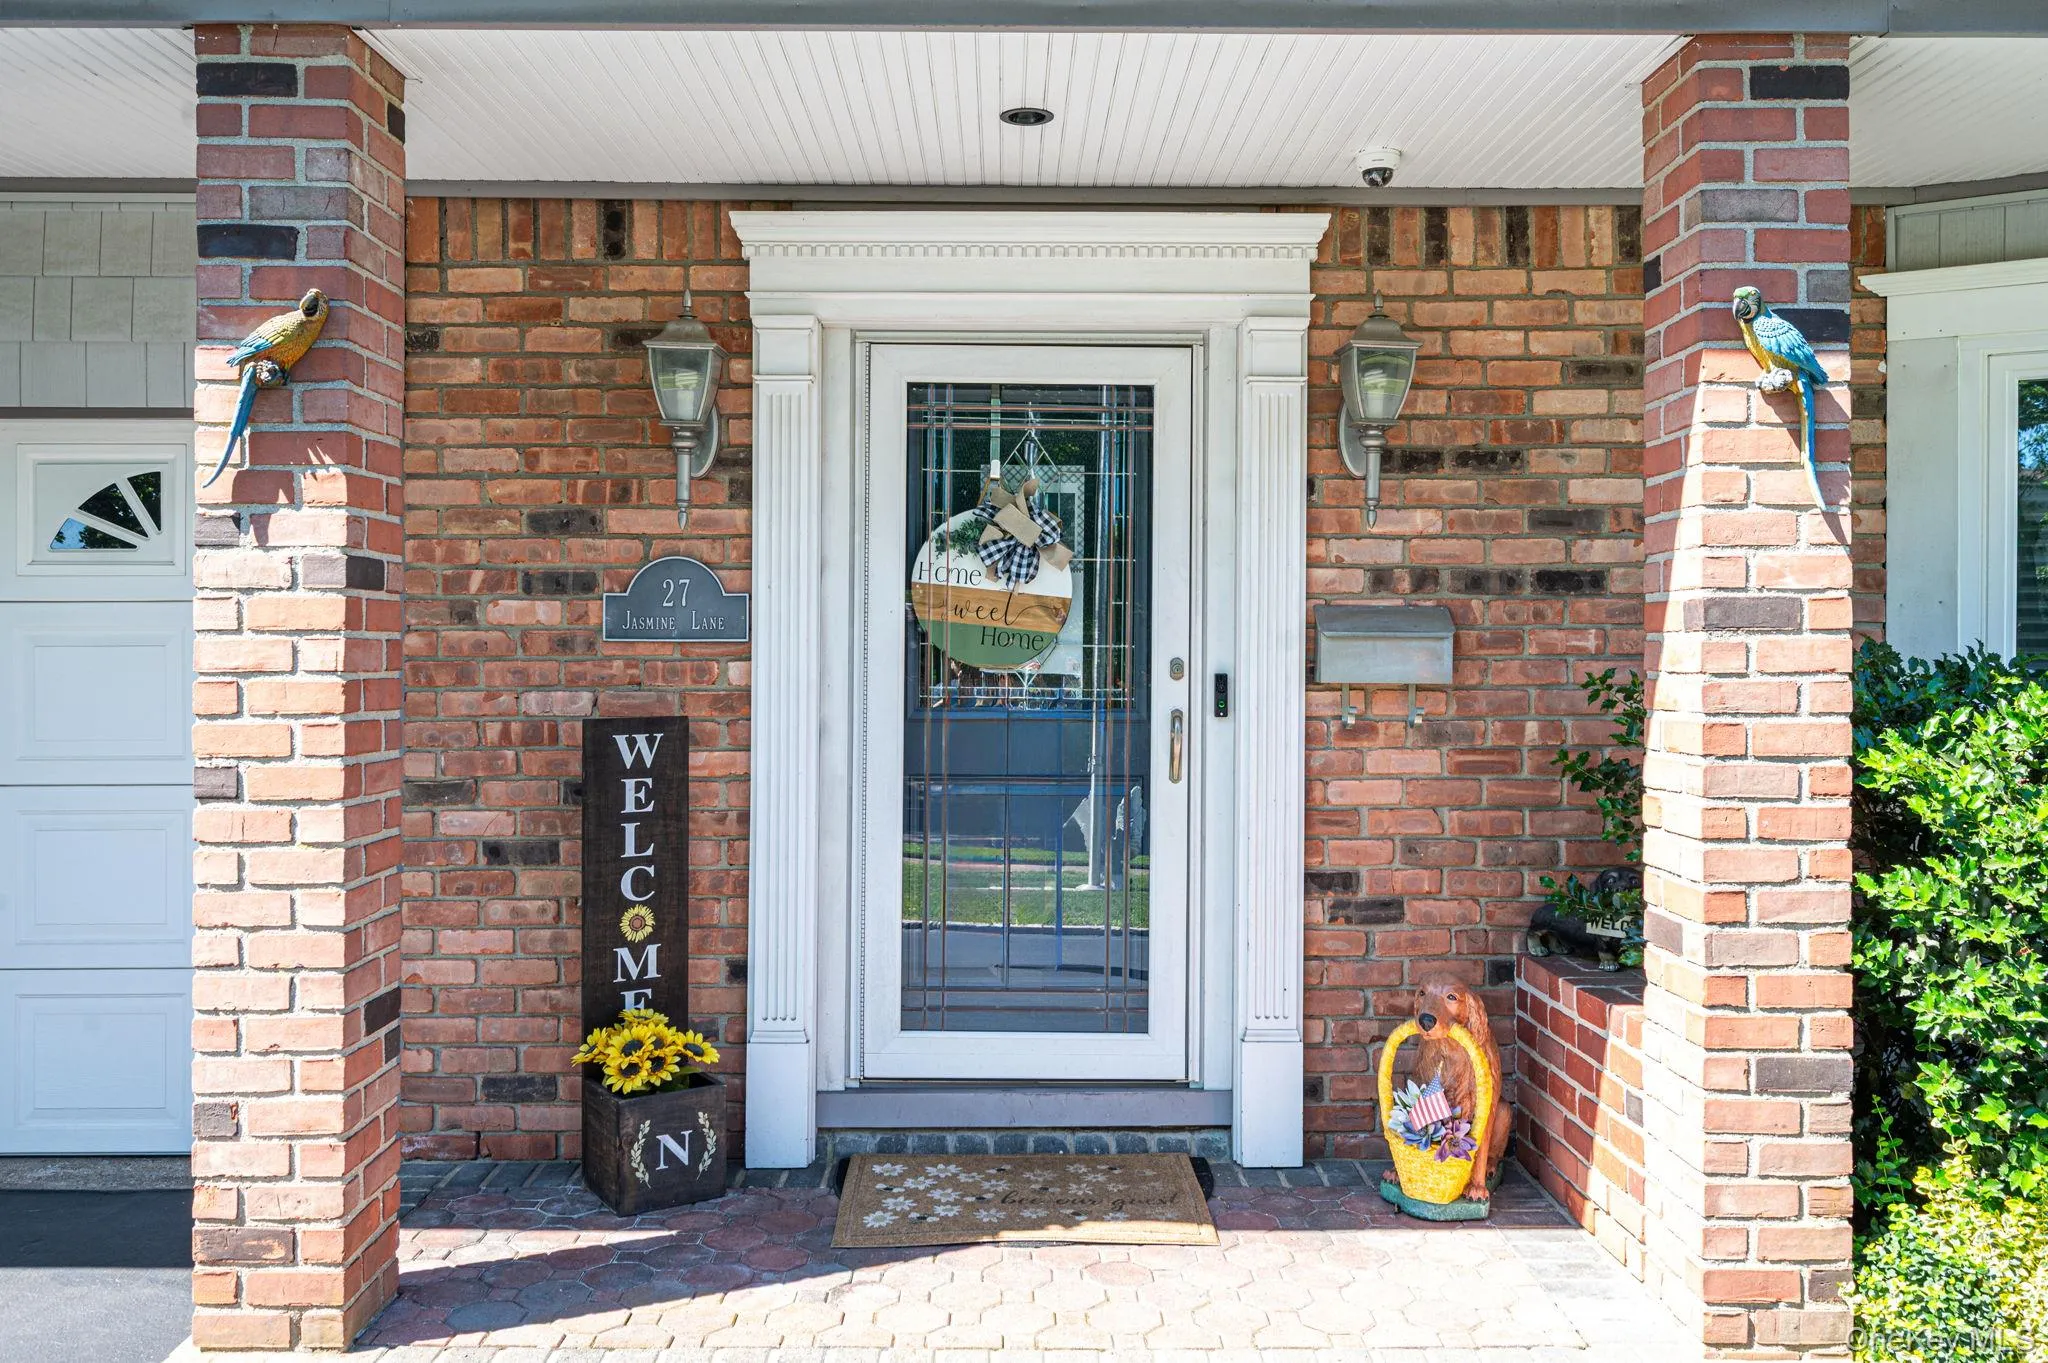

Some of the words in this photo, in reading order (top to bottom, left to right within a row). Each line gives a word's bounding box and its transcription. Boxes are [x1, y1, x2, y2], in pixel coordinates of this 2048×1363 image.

[918, 561, 982, 586] Home
[662, 578, 691, 607] 27
[622, 610, 676, 630] JASMINE
[691, 610, 725, 630] LANE
[980, 626, 1044, 651] Home
[655, 1129, 693, 1171] N
